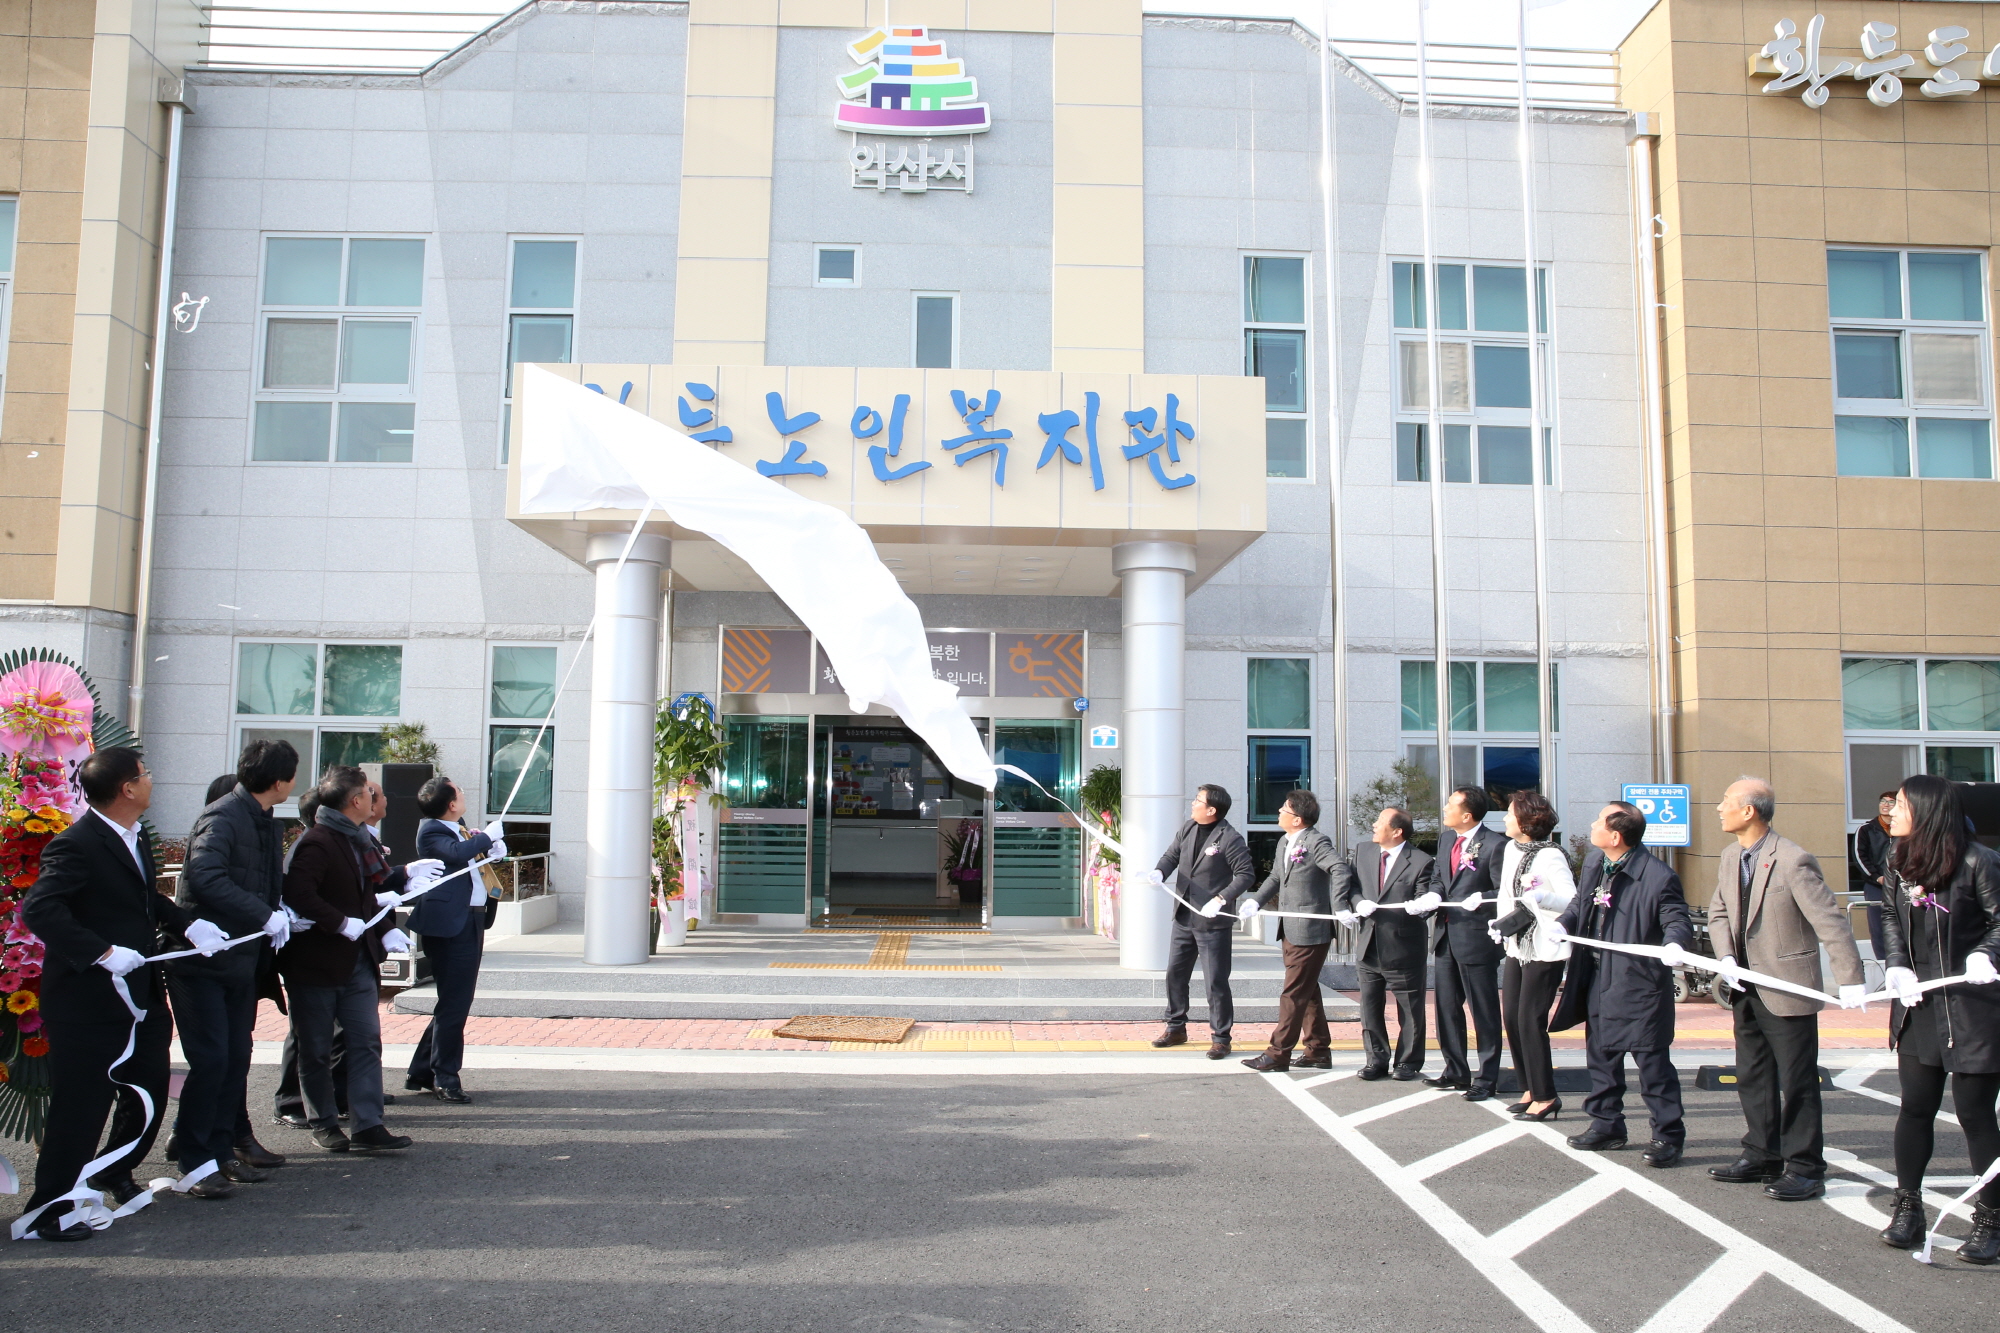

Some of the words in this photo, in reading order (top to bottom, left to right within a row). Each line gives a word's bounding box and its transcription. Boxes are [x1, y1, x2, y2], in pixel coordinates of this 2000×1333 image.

[1761, 13, 2000, 109] 황등도
[850, 143, 973, 193] 익산시
[584, 381, 1197, 492] 등노인복지관
[1101, 736, 1109, 746] 7
[1630, 788, 1647, 796] 장애인
[1648, 788, 1660, 796] 전용
[1660, 788, 1683, 796] 주차구역
[1636, 799, 1655, 815] P
